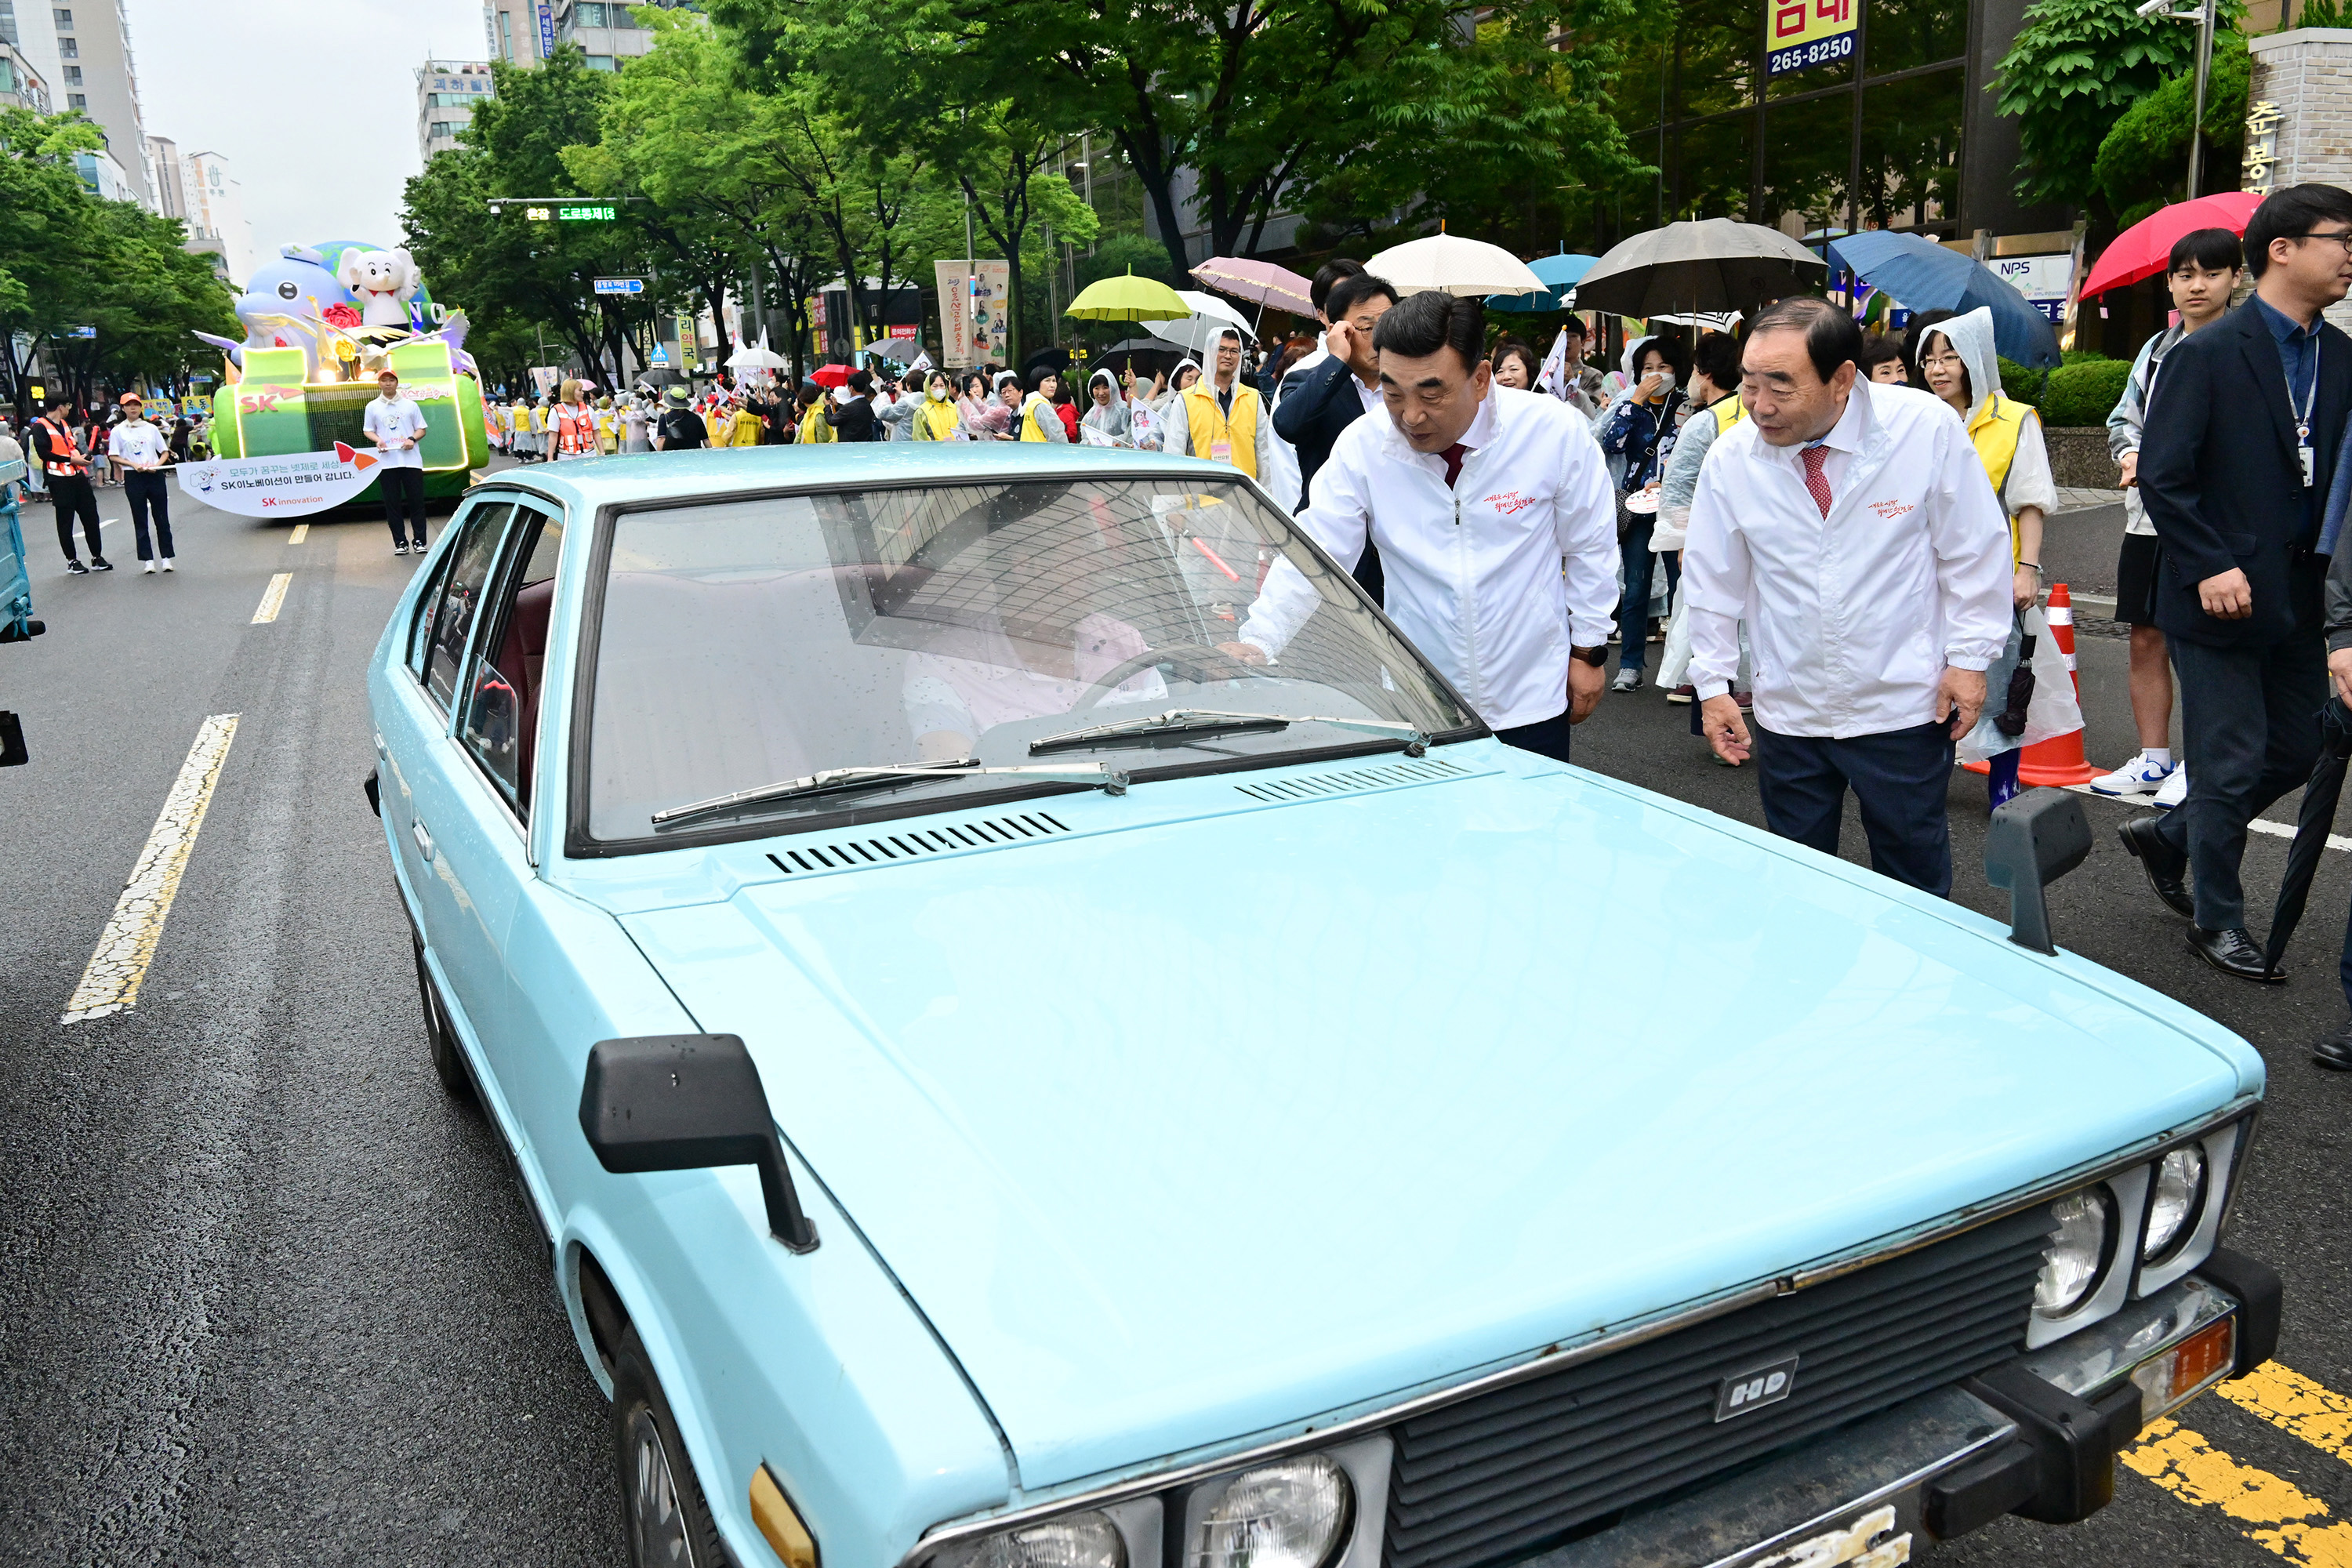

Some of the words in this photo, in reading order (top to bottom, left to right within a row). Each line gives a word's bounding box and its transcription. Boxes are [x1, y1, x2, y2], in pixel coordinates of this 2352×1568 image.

[1772, 36, 1852, 72] 265-8250
[2001, 261, 2030, 275] NPS
[240, 395, 278, 413] SK
[230, 467, 258, 477] 모두가
[261, 465, 289, 475] 꿈꾸는
[291, 463, 318, 472] 넷제로
[221, 476, 292, 490] SK이노베이션이
[294, 474, 322, 484] 만들어
[325, 471, 354, 481] 갑니다.
[262, 497, 277, 507] SK
[278, 495, 323, 506] innovation
[1495, 501, 1513, 512] 위대한
[1730, 1371, 1787, 1407] HD
